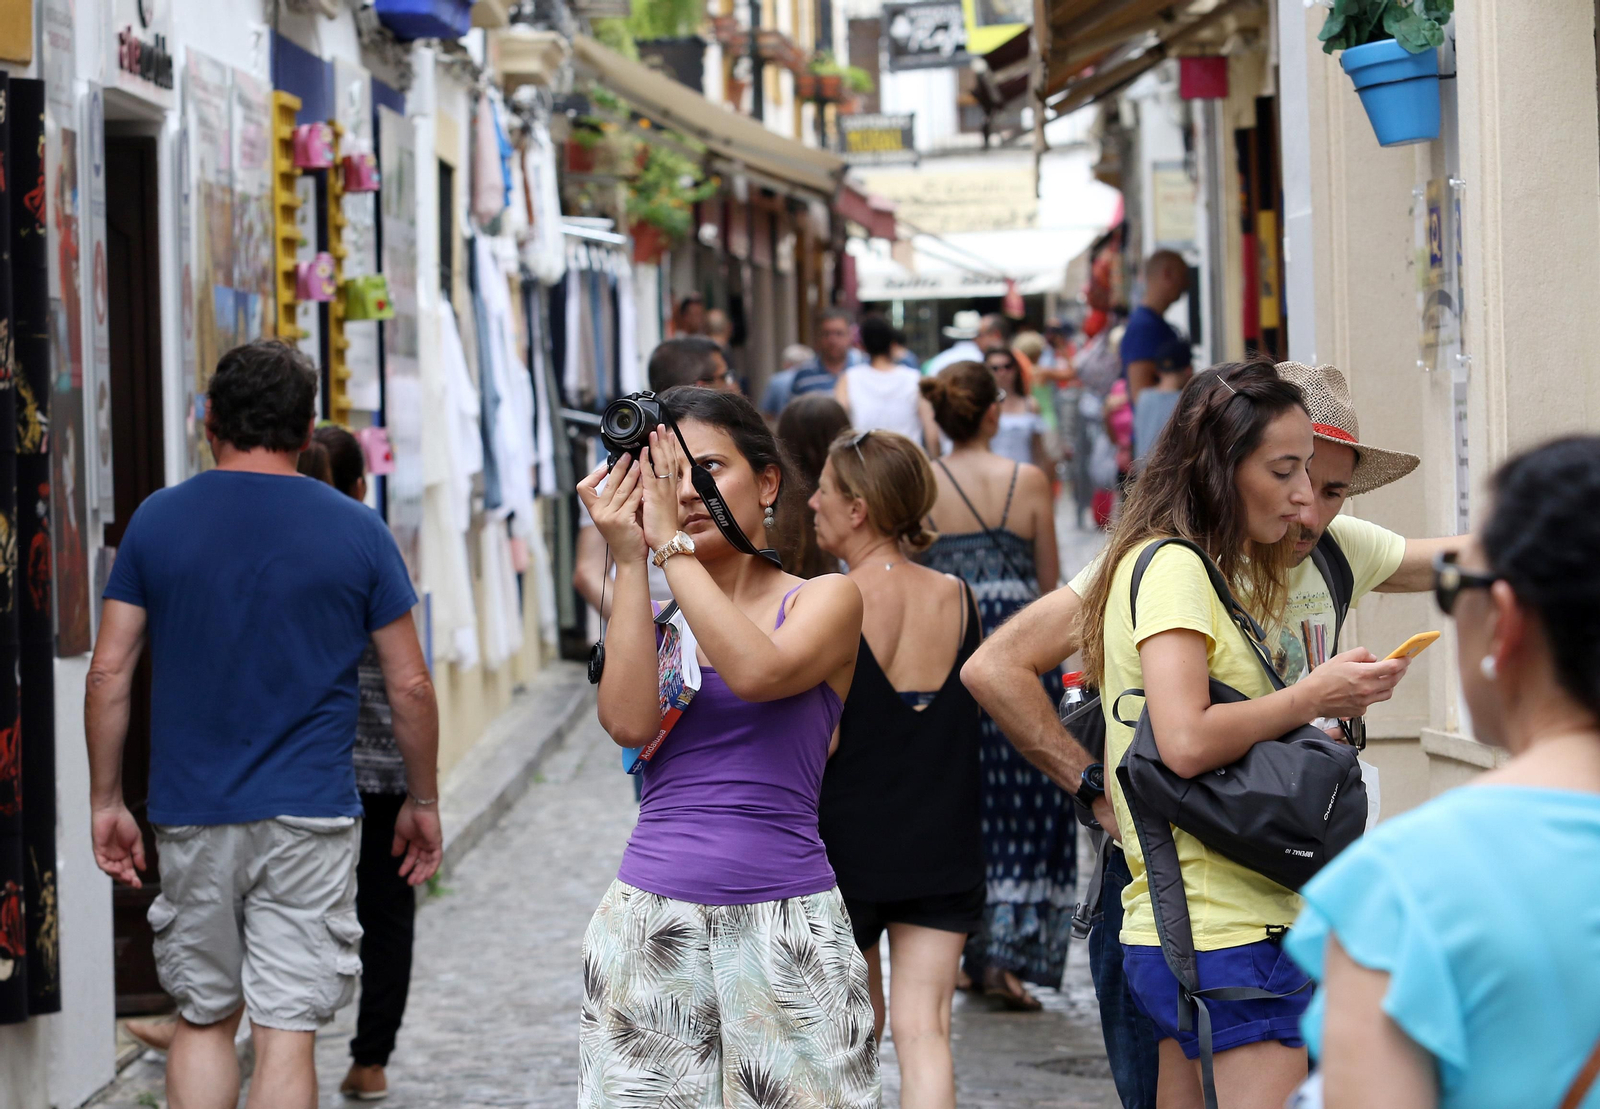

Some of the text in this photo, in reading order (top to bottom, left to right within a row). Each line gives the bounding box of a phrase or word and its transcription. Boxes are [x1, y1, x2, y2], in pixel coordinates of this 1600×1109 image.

[707, 497, 729, 527] Nikon
[641, 729, 667, 759] Andalusia
[1292, 849, 1313, 858] ARPENAZ
